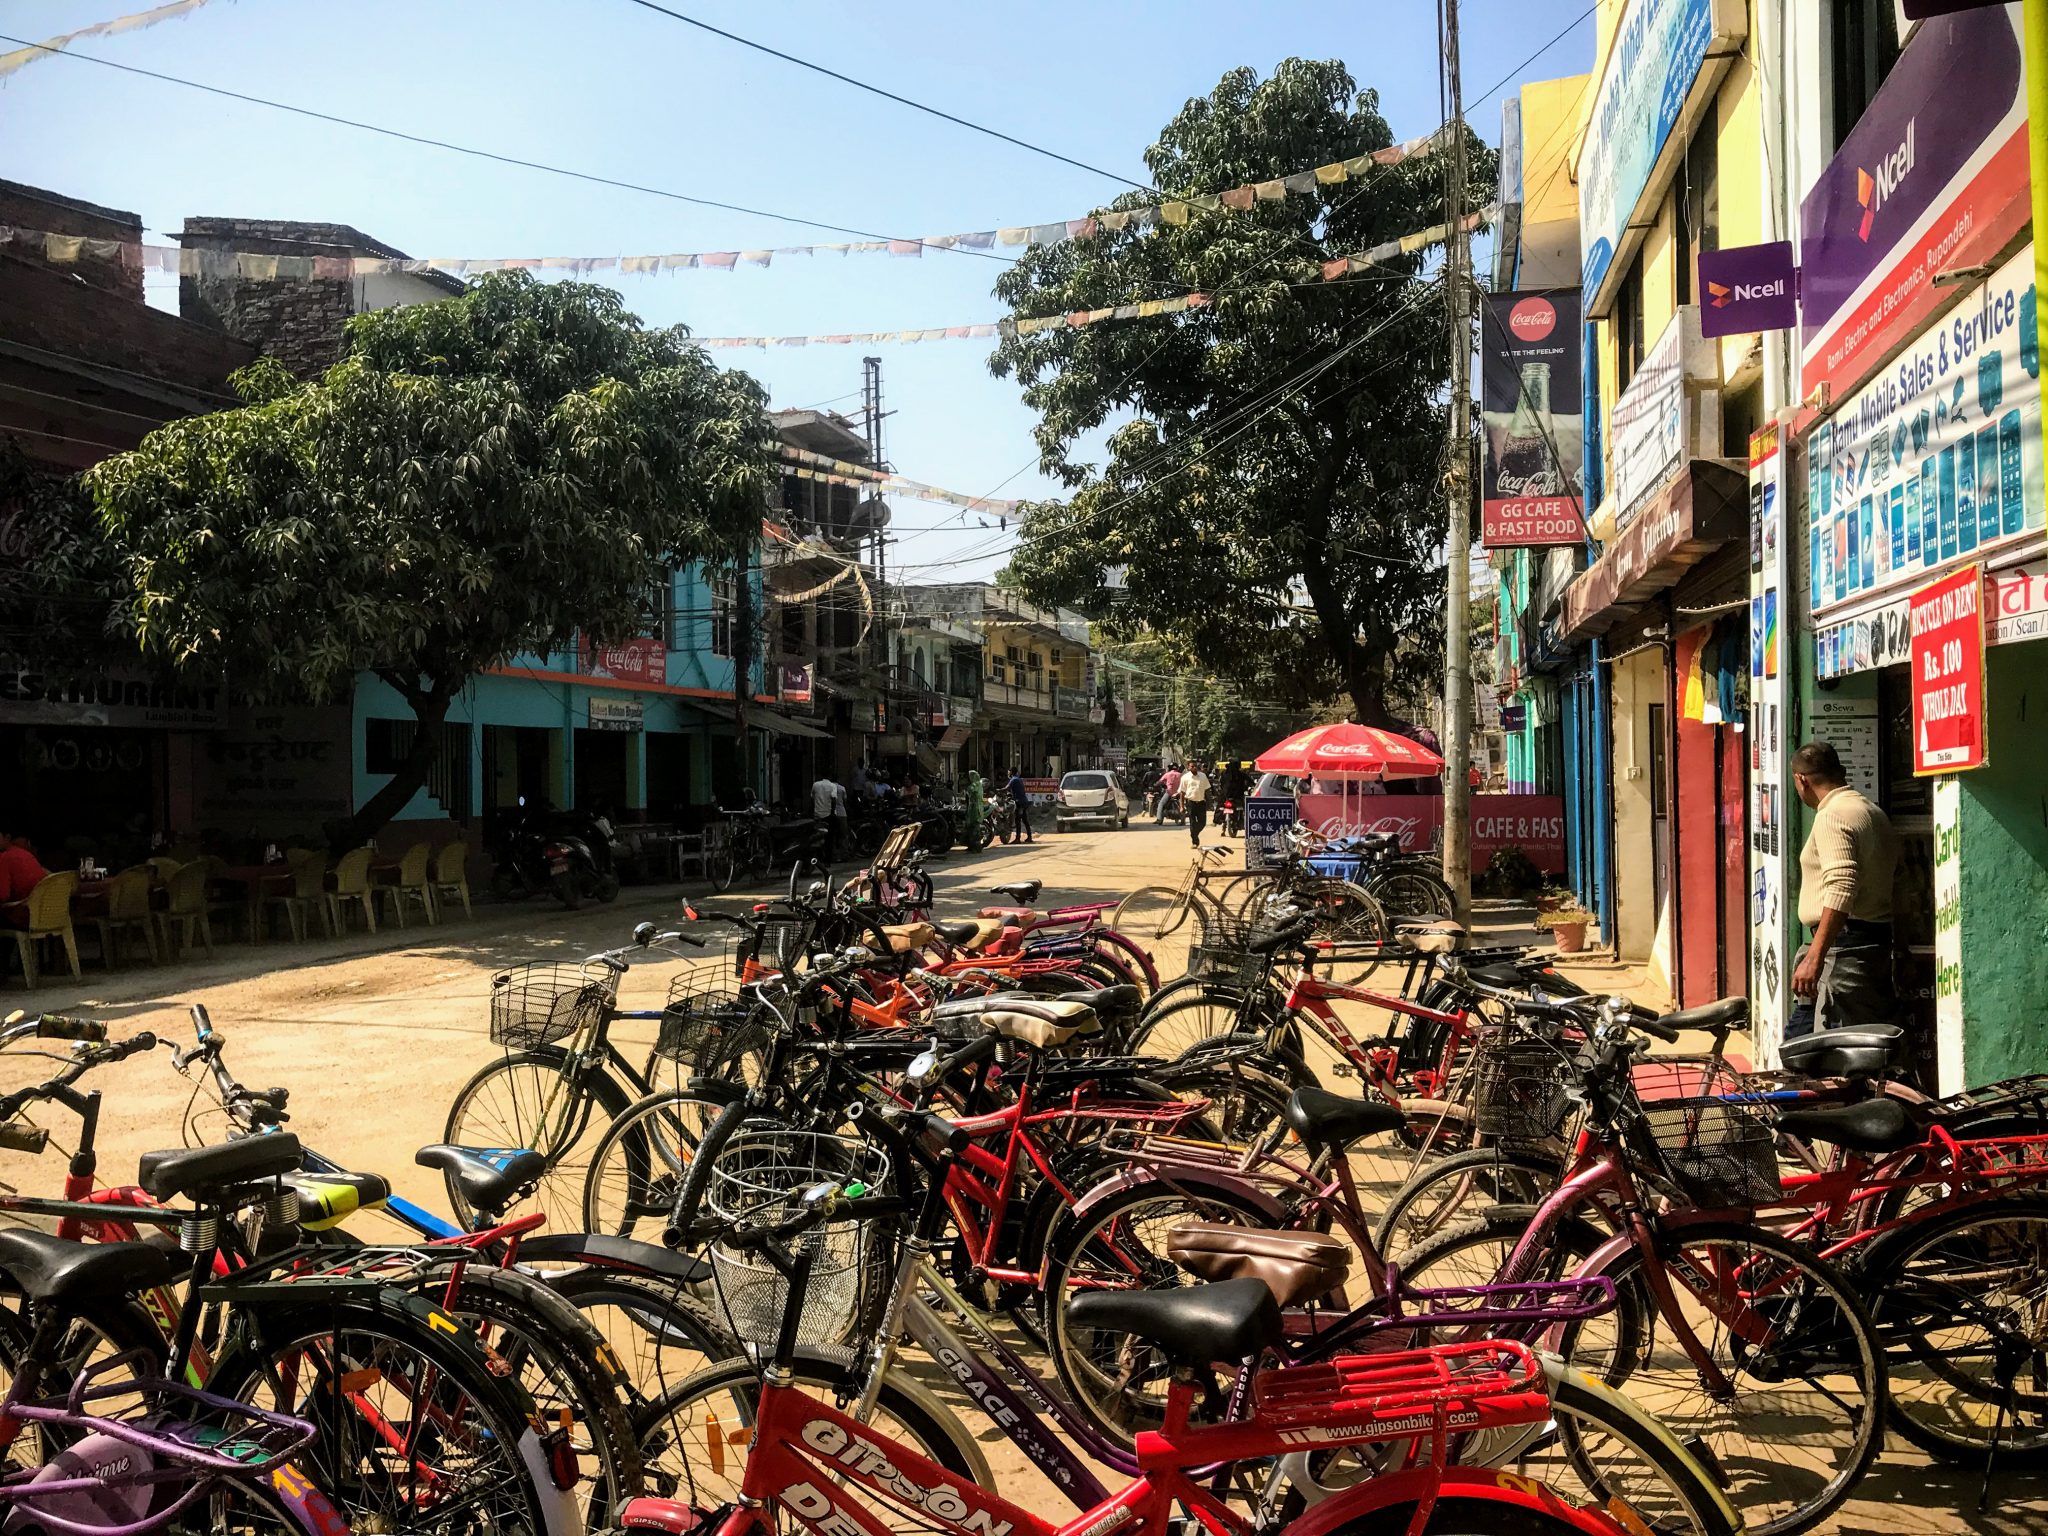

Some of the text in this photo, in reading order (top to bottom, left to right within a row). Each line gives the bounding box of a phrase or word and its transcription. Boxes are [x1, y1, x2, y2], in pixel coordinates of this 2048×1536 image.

[1876, 116, 1916, 212] Ncell
[1734, 280, 1784, 301] Ncell
[1827, 344, 1845, 371] Ramu
[1844, 317, 1868, 355] Electric
[1868, 302, 1882, 332] and
[1927, 205, 1974, 272] Rupandehi
[1536, 347, 1564, 355] FEELING
[1830, 413, 1858, 458] Ramu
[1861, 381, 1896, 432] Mobile
[1900, 353, 1934, 405] Sales
[1938, 330, 1949, 377] &
[1953, 288, 2015, 365] Service
[1486, 519, 1577, 537] & FAST FOOD
[1501, 501, 1561, 518] GG CAFE
[1912, 580, 1976, 637] BICYCLE ON RENT
[2016, 618, 2038, 636] Scan
[1924, 638, 1962, 681] Rs. 100
[1922, 682, 1967, 722] WHOLE DAY
[1249, 808, 1292, 820] G.G.CAFE
[1266, 822, 1275, 832] &
[1475, 816, 1514, 838] CAFE
[1517, 817, 1528, 838] &
[1935, 807, 1959, 868] Card
[1936, 956, 1960, 999] Here
[970, 1325, 1048, 1408] STYLE CLASSIC
[937, 1347, 1020, 1428] GRACE
[802, 1418, 1014, 1536] GIPSON
[633, 1517, 664, 1528] GIPSON
